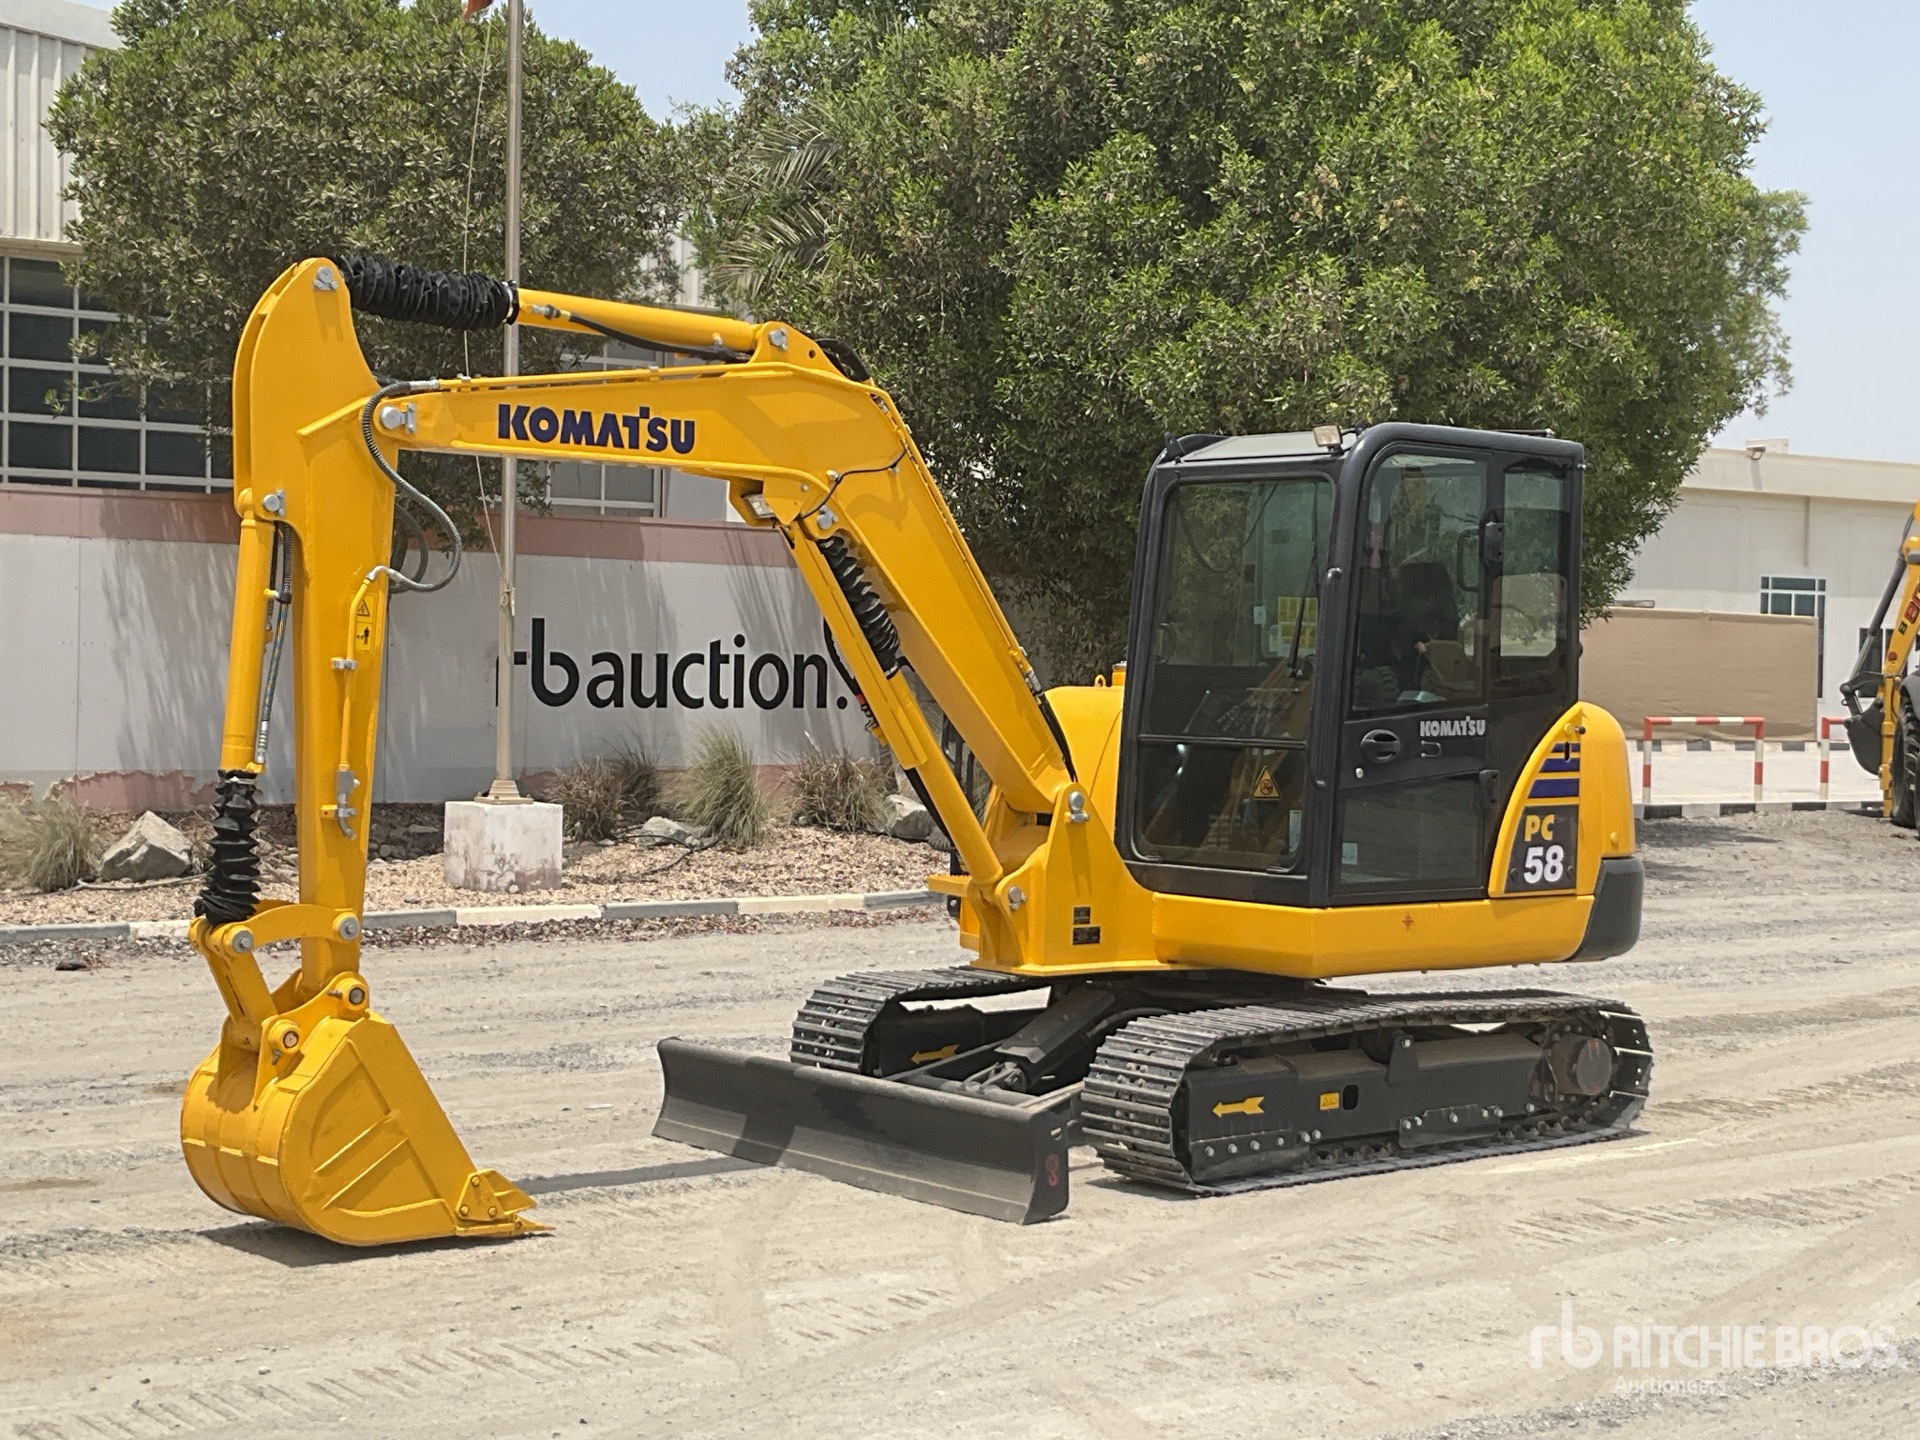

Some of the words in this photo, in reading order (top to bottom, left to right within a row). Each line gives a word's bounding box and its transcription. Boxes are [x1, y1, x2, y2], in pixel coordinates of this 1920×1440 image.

[498, 403, 696, 454] KOMATSU
[1419, 715, 1486, 737] KOMATSU
[1523, 813, 1555, 842] PC
[1523, 844, 1565, 884] 58
